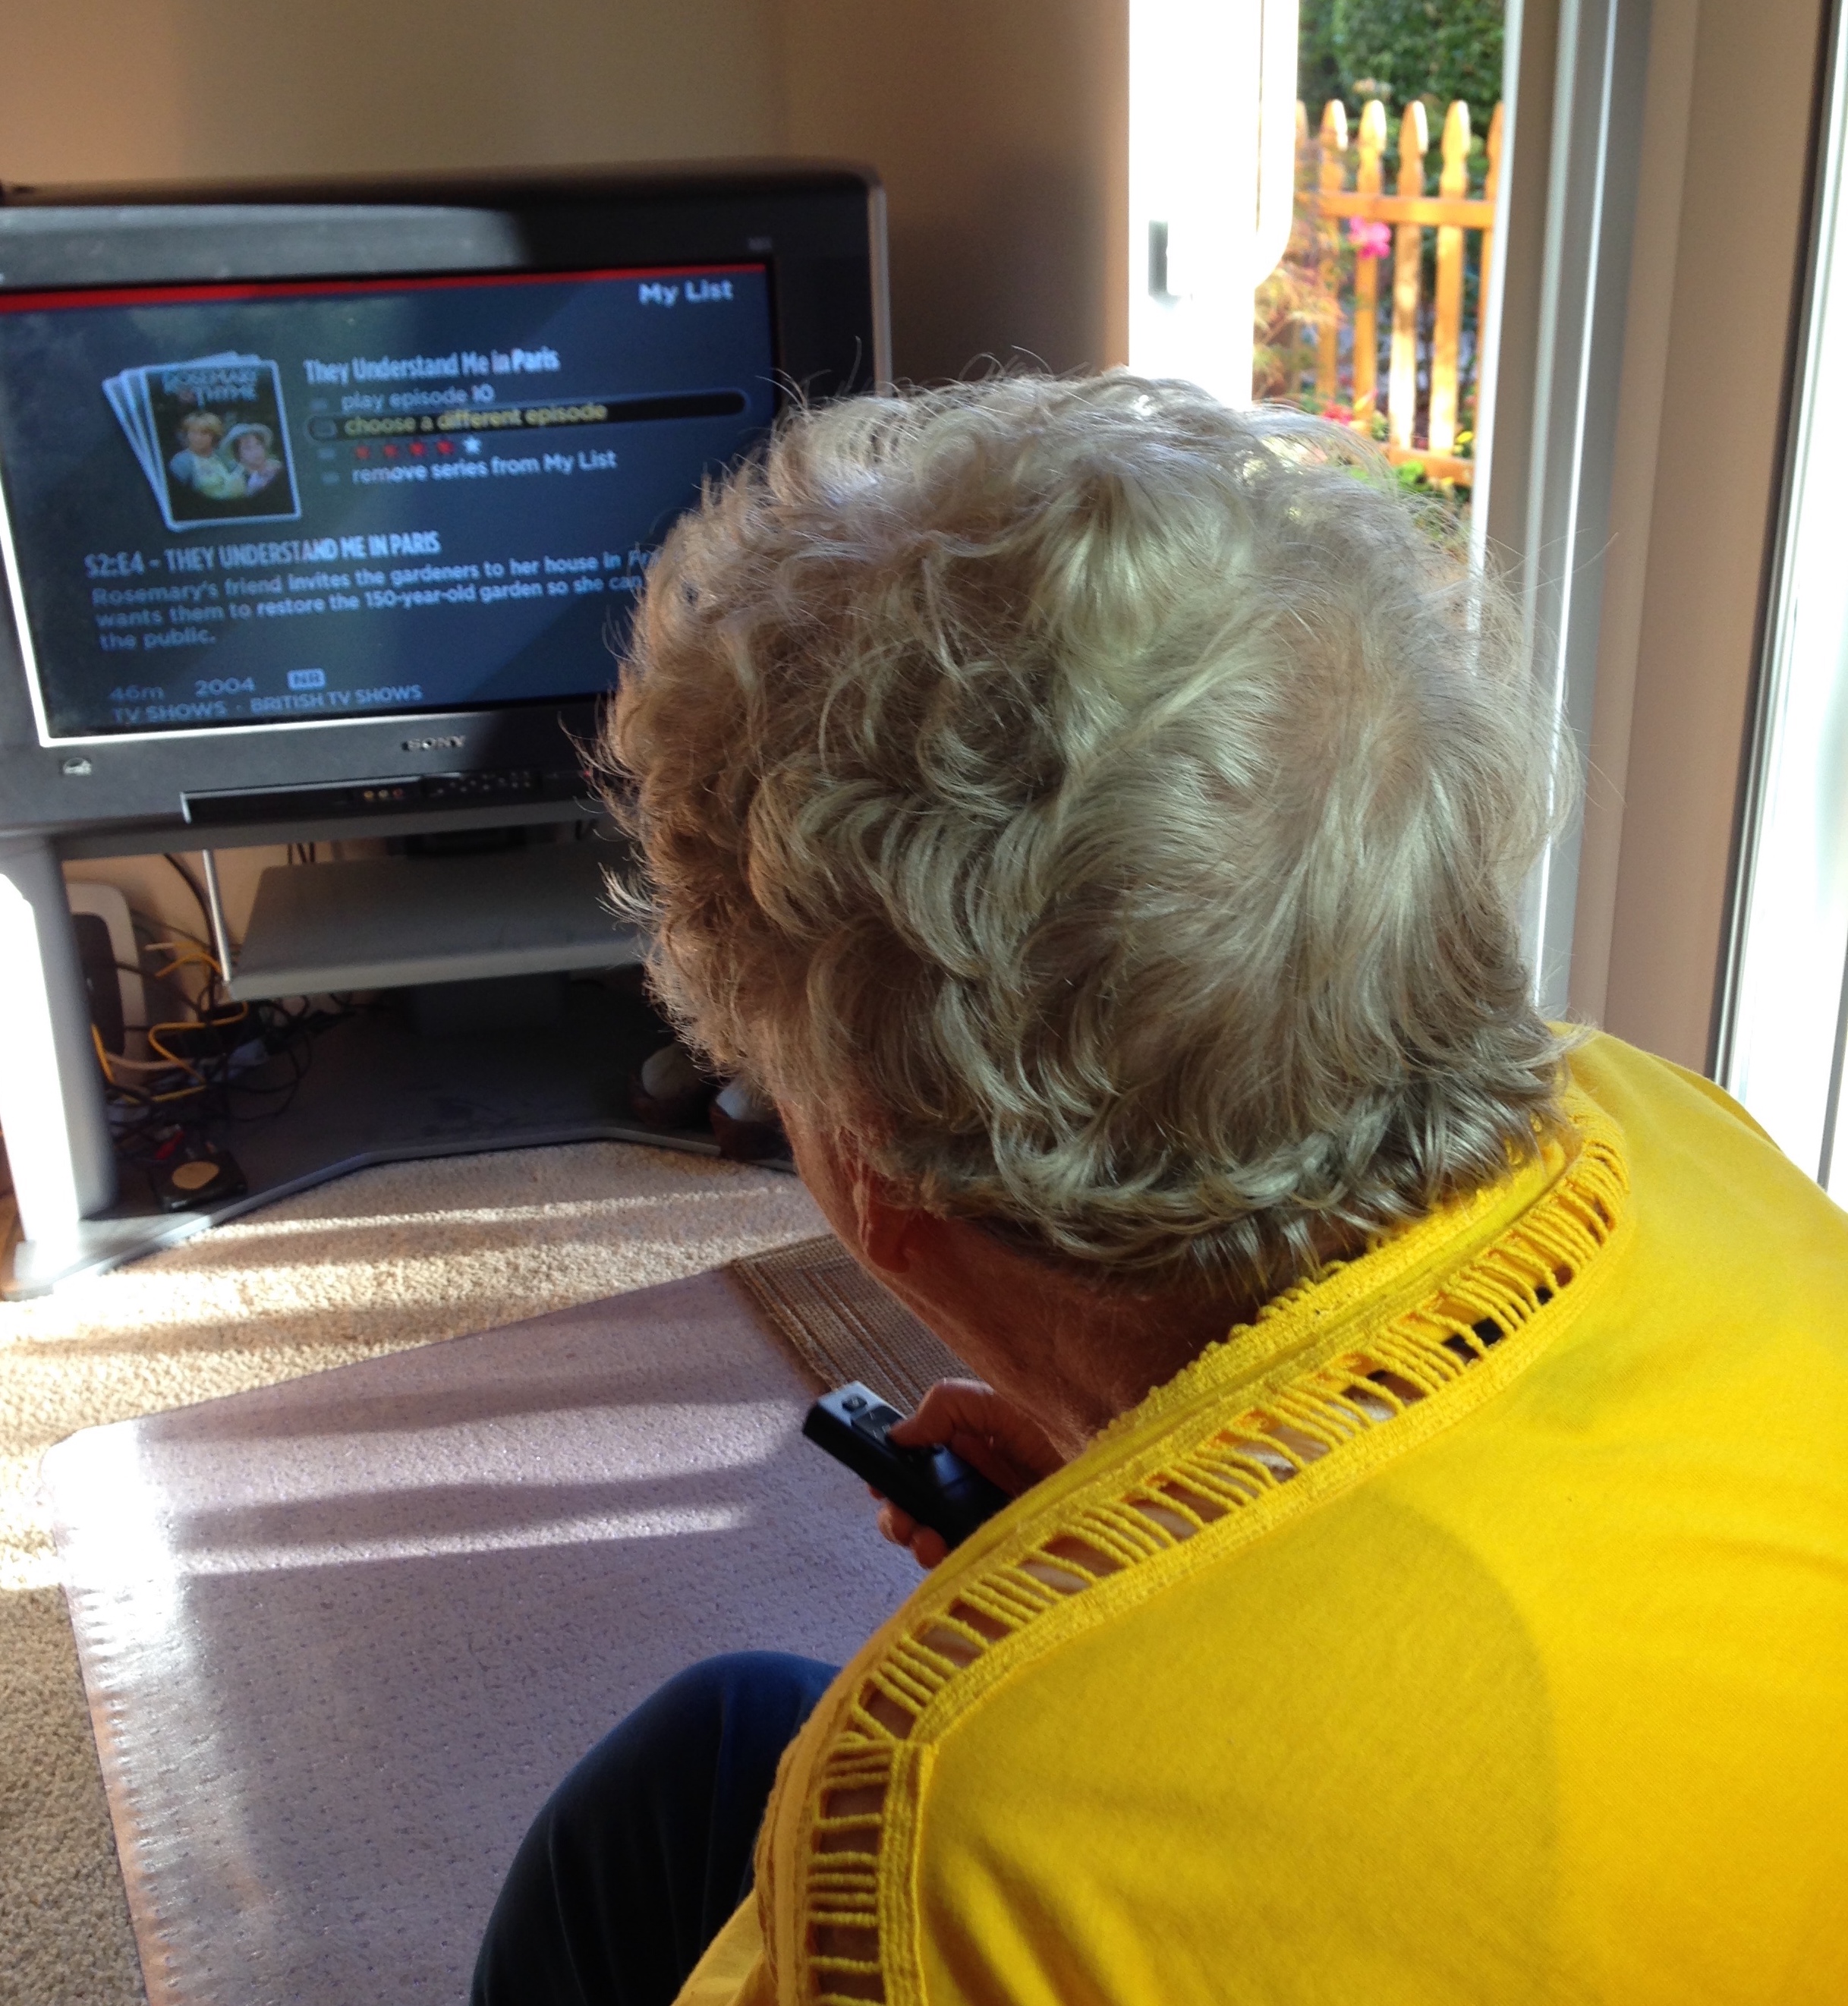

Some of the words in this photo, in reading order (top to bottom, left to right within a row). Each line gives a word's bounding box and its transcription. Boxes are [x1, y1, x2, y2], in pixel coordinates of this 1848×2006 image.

[638, 282, 679, 308] My
[685, 279, 734, 303] List
[304, 357, 350, 386] They
[351, 352, 458, 381] Understand
[461, 351, 490, 376] Me
[491, 350, 511, 375] in
[511, 345, 562, 372] Paris
[340, 390, 384, 413] play
[389, 384, 468, 410] episode
[344, 415, 417, 437] choose
[420, 416, 434, 433] a
[436, 408, 523, 431] different
[524, 402, 608, 427] episode
[351, 464, 428, 485] remove
[431, 458, 489, 480] series
[490, 455, 540, 477] from
[543, 454, 575, 476] My
[578, 449, 618, 471] List
[164, 546, 215, 573] THEY
[219, 537, 339, 569] UNDERSTAND
[339, 534, 367, 560] ME
[368, 534, 389, 559] IN
[389, 531, 442, 556] PARIS
[92, 580, 219, 606] Rosemary's
[225, 575, 283, 597] friend
[288, 570, 352, 592] invites
[354, 567, 386, 587] the
[389, 561, 481, 587] gardeners
[483, 560, 505, 578] to
[508, 557, 540, 577] her
[543, 554, 600, 575] house
[603, 551, 622, 570] in
[96, 609, 164, 629] wants
[168, 604, 225, 625] them
[228, 603, 253, 620] to
[256, 597, 326, 618] restore
[329, 592, 361, 612] the
[364, 583, 477, 609] 150-year-old
[479, 580, 544, 605] garden
[546, 580, 569, 597] so
[572, 575, 605, 594] she
[609, 575, 644, 591] can
[99, 631, 137, 651] the
[109, 684, 165, 703] 46m
[194, 676, 256, 698] 2004
[113, 706, 140, 724] TV
[145, 700, 228, 722] SHOWS
[249, 691, 325, 716] BRITISH
[326, 689, 353, 707] TV
[355, 683, 424, 705] SHOWS
[404, 735, 466, 752] SONY
